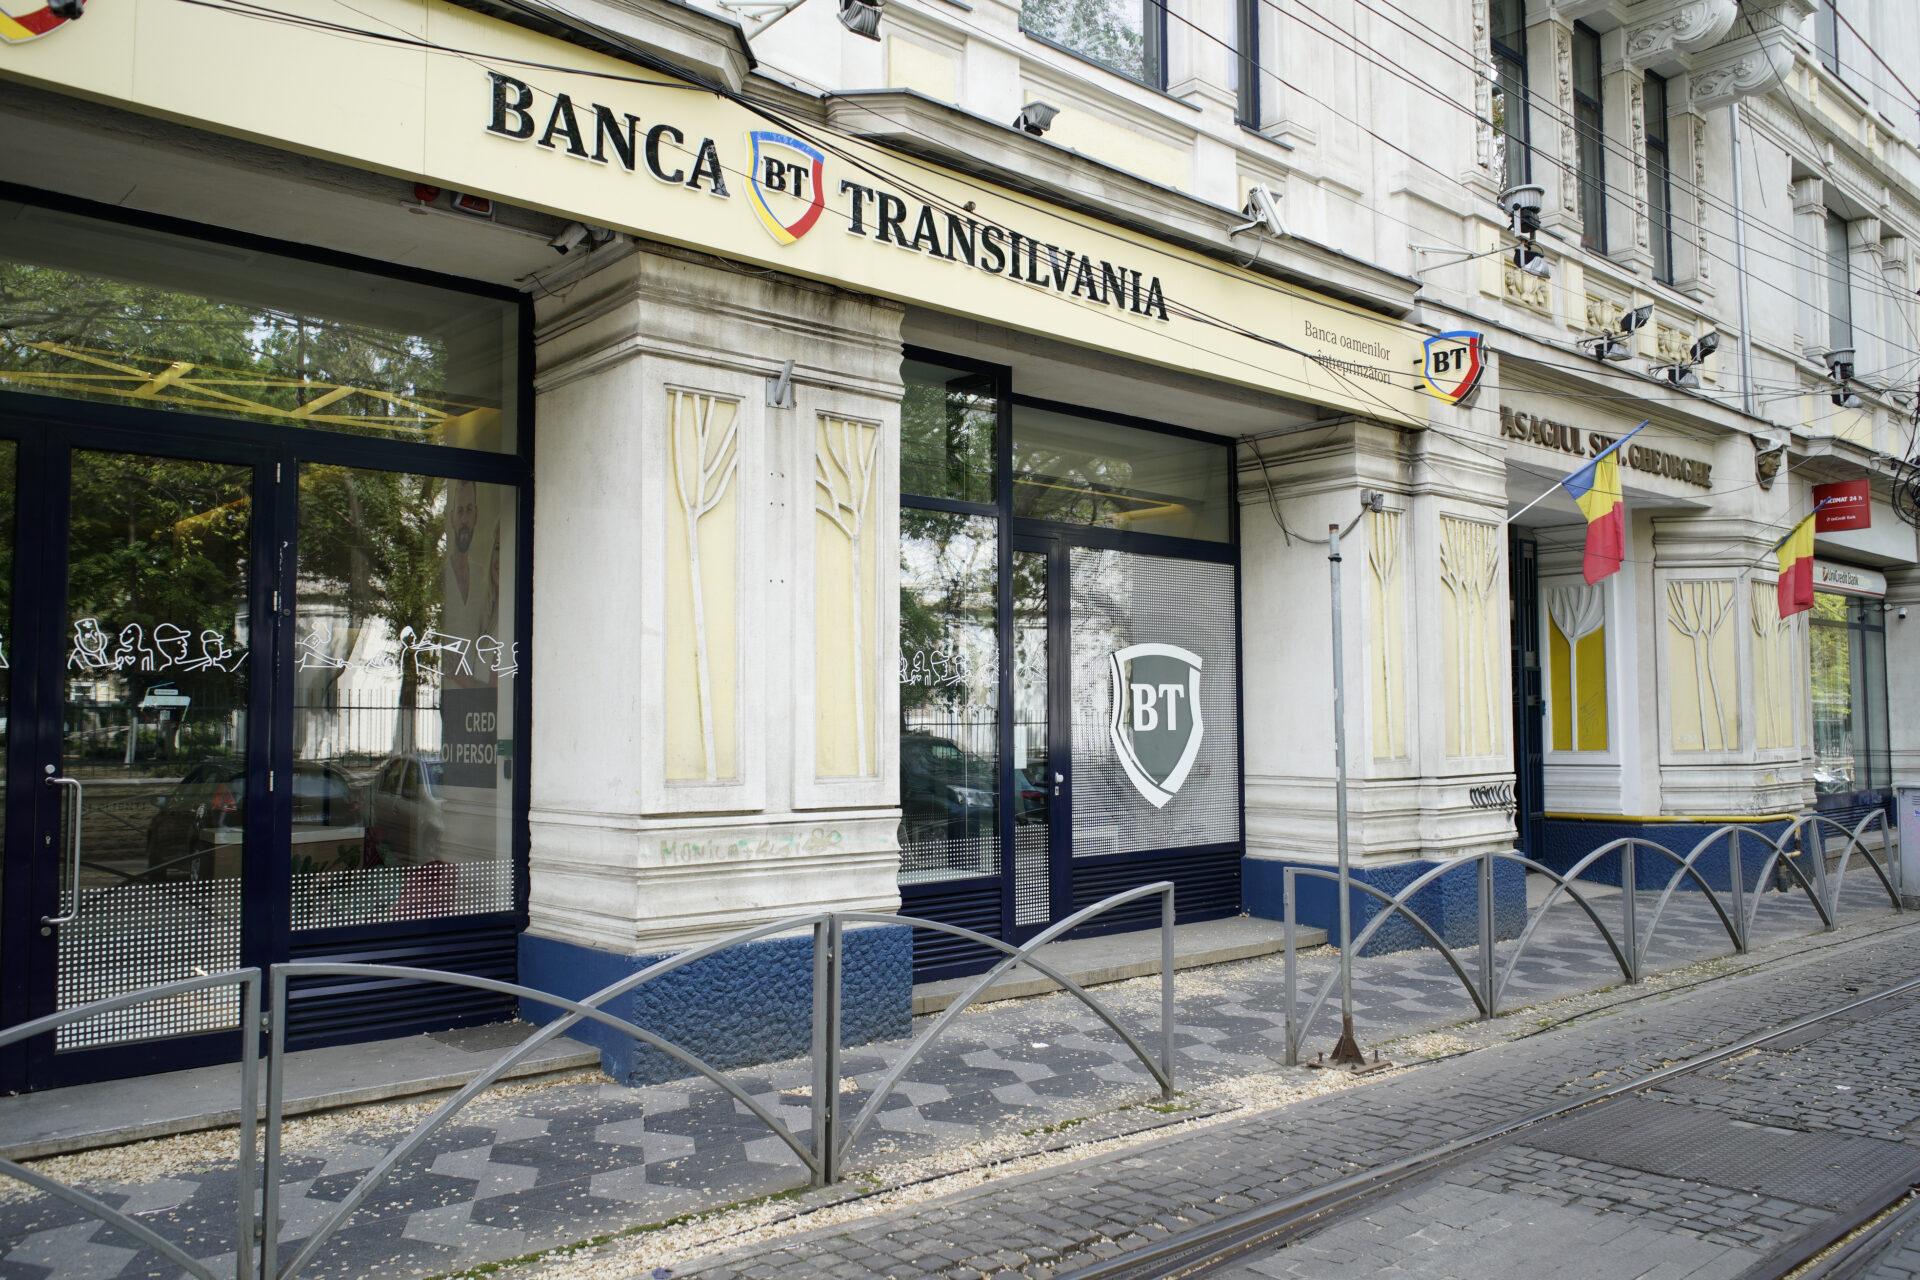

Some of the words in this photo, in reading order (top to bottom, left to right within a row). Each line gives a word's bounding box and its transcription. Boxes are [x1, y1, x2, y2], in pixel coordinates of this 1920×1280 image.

[485, 71, 730, 199] BANCA
[763, 155, 809, 197] BT
[840, 179, 1169, 321] TRANSILVANIA
[1305, 320, 1337, 345] Banca
[1340, 335, 1390, 360] oamenilor
[1433, 347, 1467, 373] BT
[1628, 443, 1713, 489] GHEORGHE
[1820, 496, 1847, 505] COMAT
[1131, 683, 1185, 731] BT
